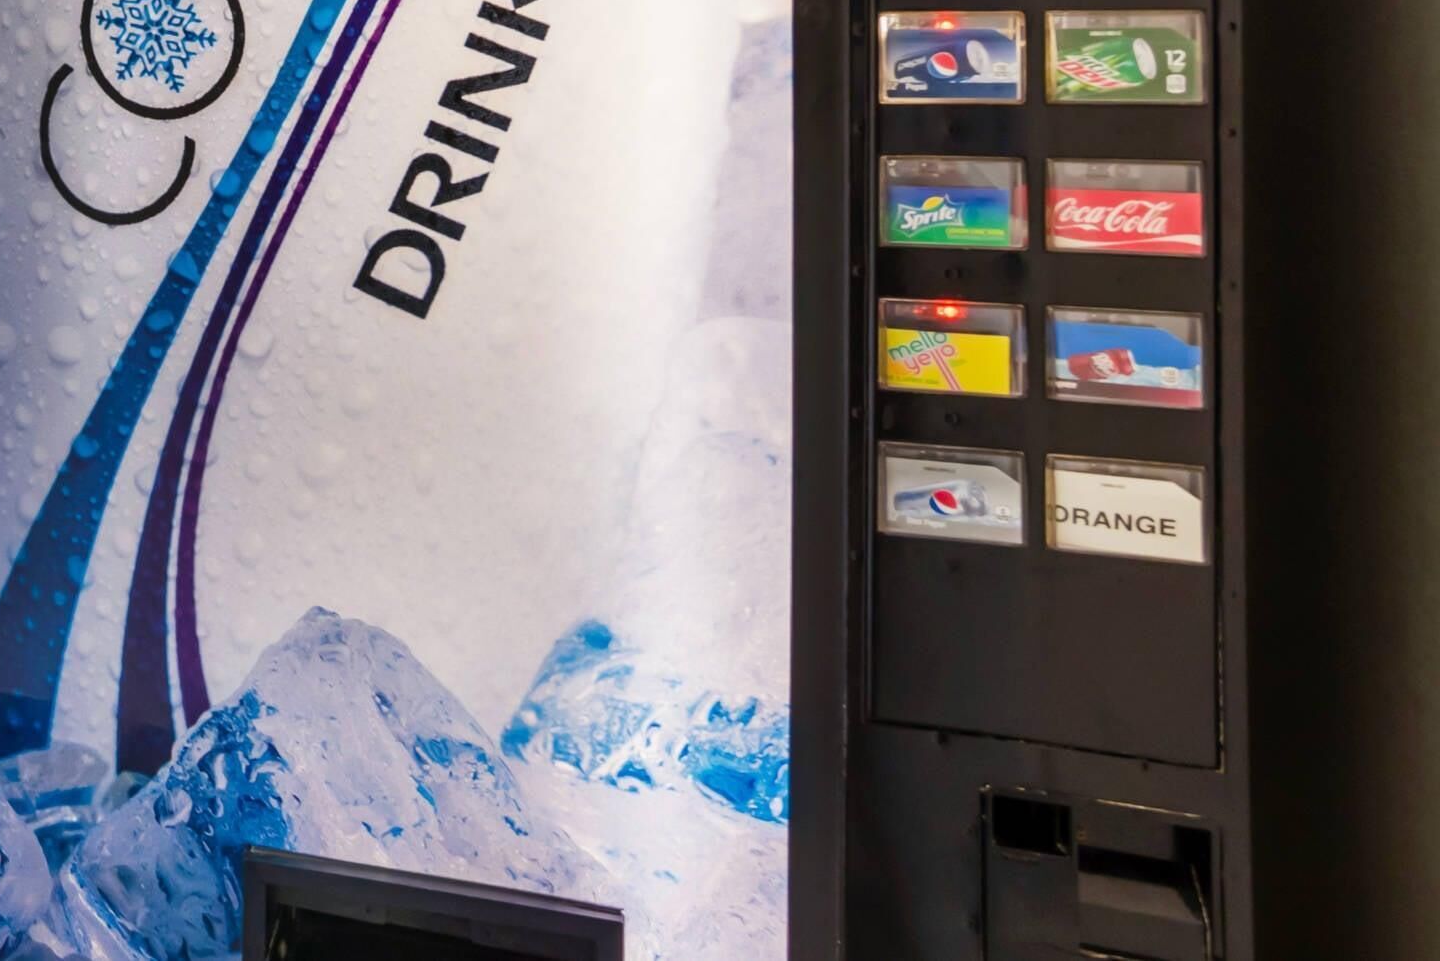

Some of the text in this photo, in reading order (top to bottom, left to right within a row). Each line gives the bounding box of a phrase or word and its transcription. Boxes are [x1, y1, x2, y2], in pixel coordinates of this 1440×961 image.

[1164, 49, 1186, 66] 12
[901, 206, 956, 230] Sprite
[888, 331, 948, 360] mello
[1052, 505, 1177, 537] ORANGE
